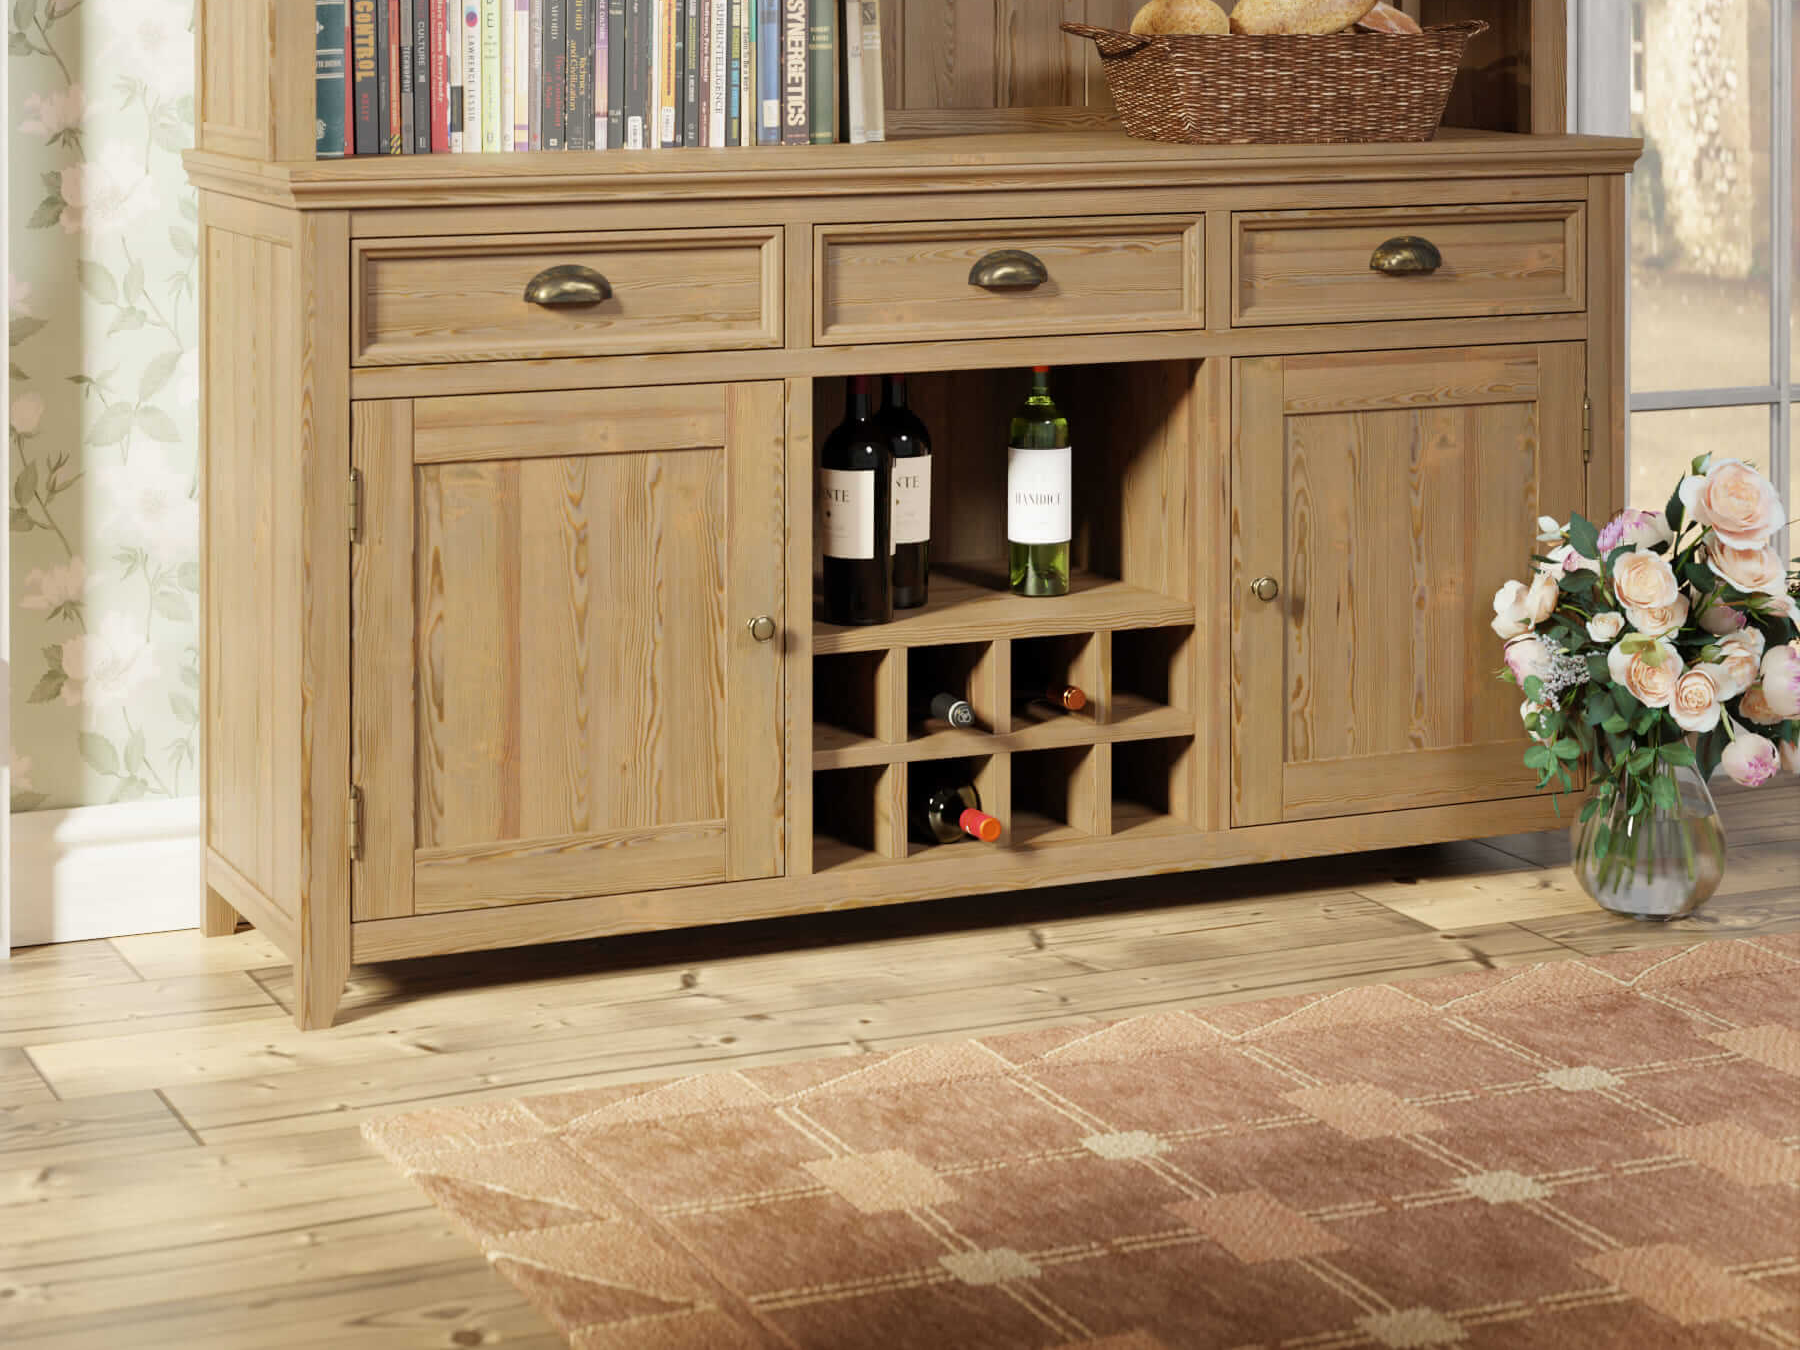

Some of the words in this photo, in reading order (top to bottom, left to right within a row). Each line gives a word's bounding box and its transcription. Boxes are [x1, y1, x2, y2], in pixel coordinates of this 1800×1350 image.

[355, 1, 375, 82] CONTROL
[417, 21, 426, 66] CULTURE
[715, 3, 725, 114] SUPERINTELLIGENCE
